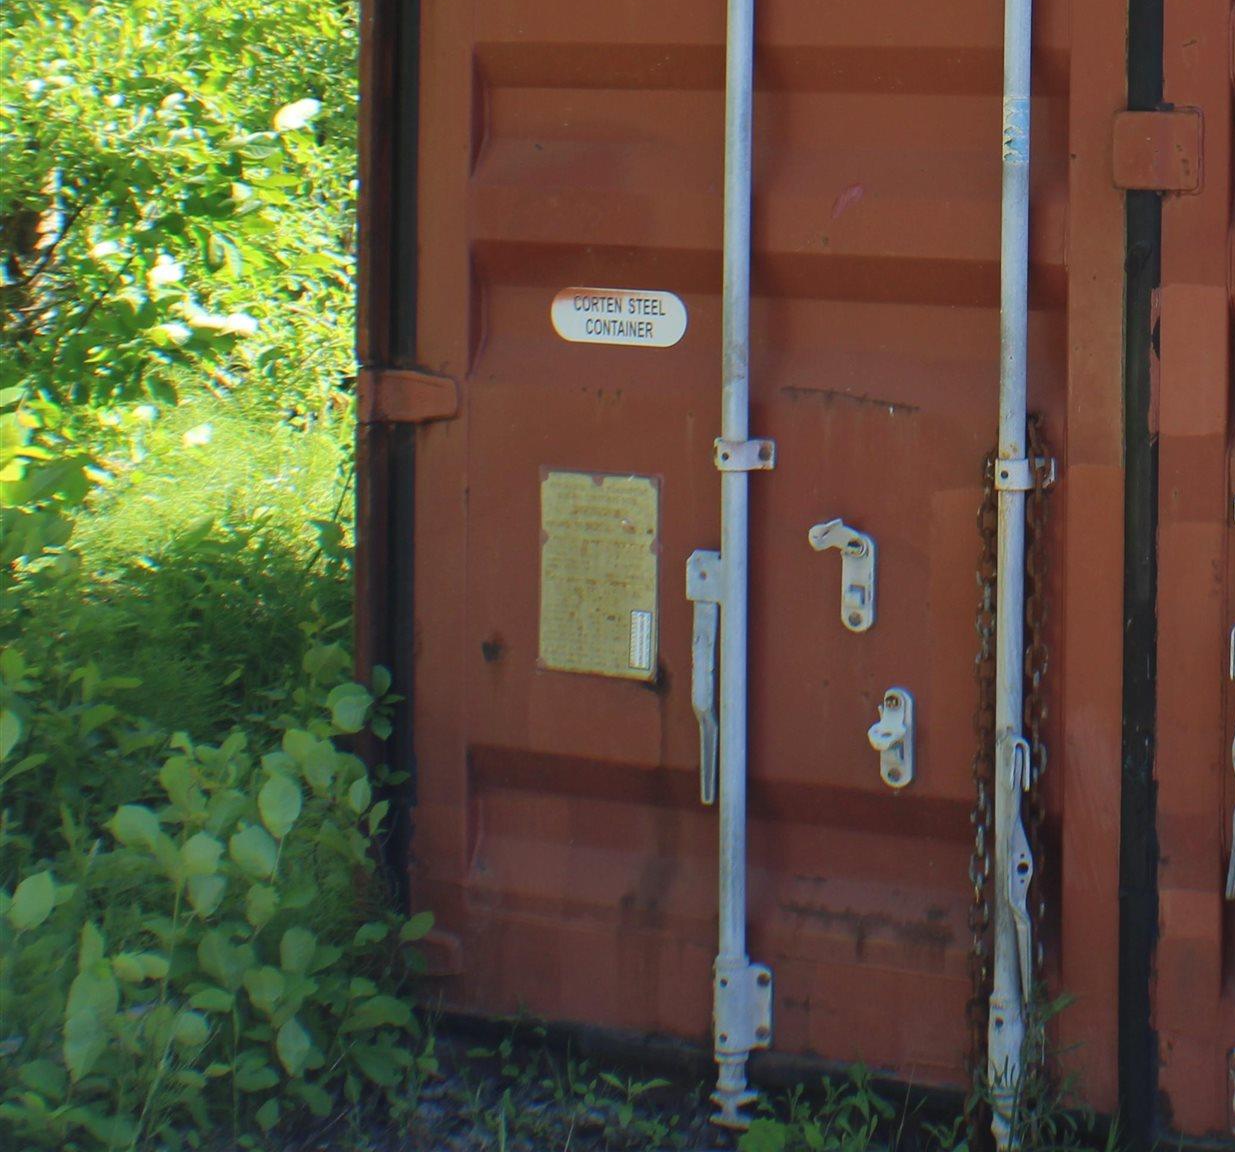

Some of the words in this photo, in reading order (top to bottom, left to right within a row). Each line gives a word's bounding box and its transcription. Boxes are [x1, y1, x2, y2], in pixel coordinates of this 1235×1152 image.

[573, 295, 622, 314] CORTEN
[628, 298, 667, 316] STEEL
[585, 318, 654, 338] CONTAINER
